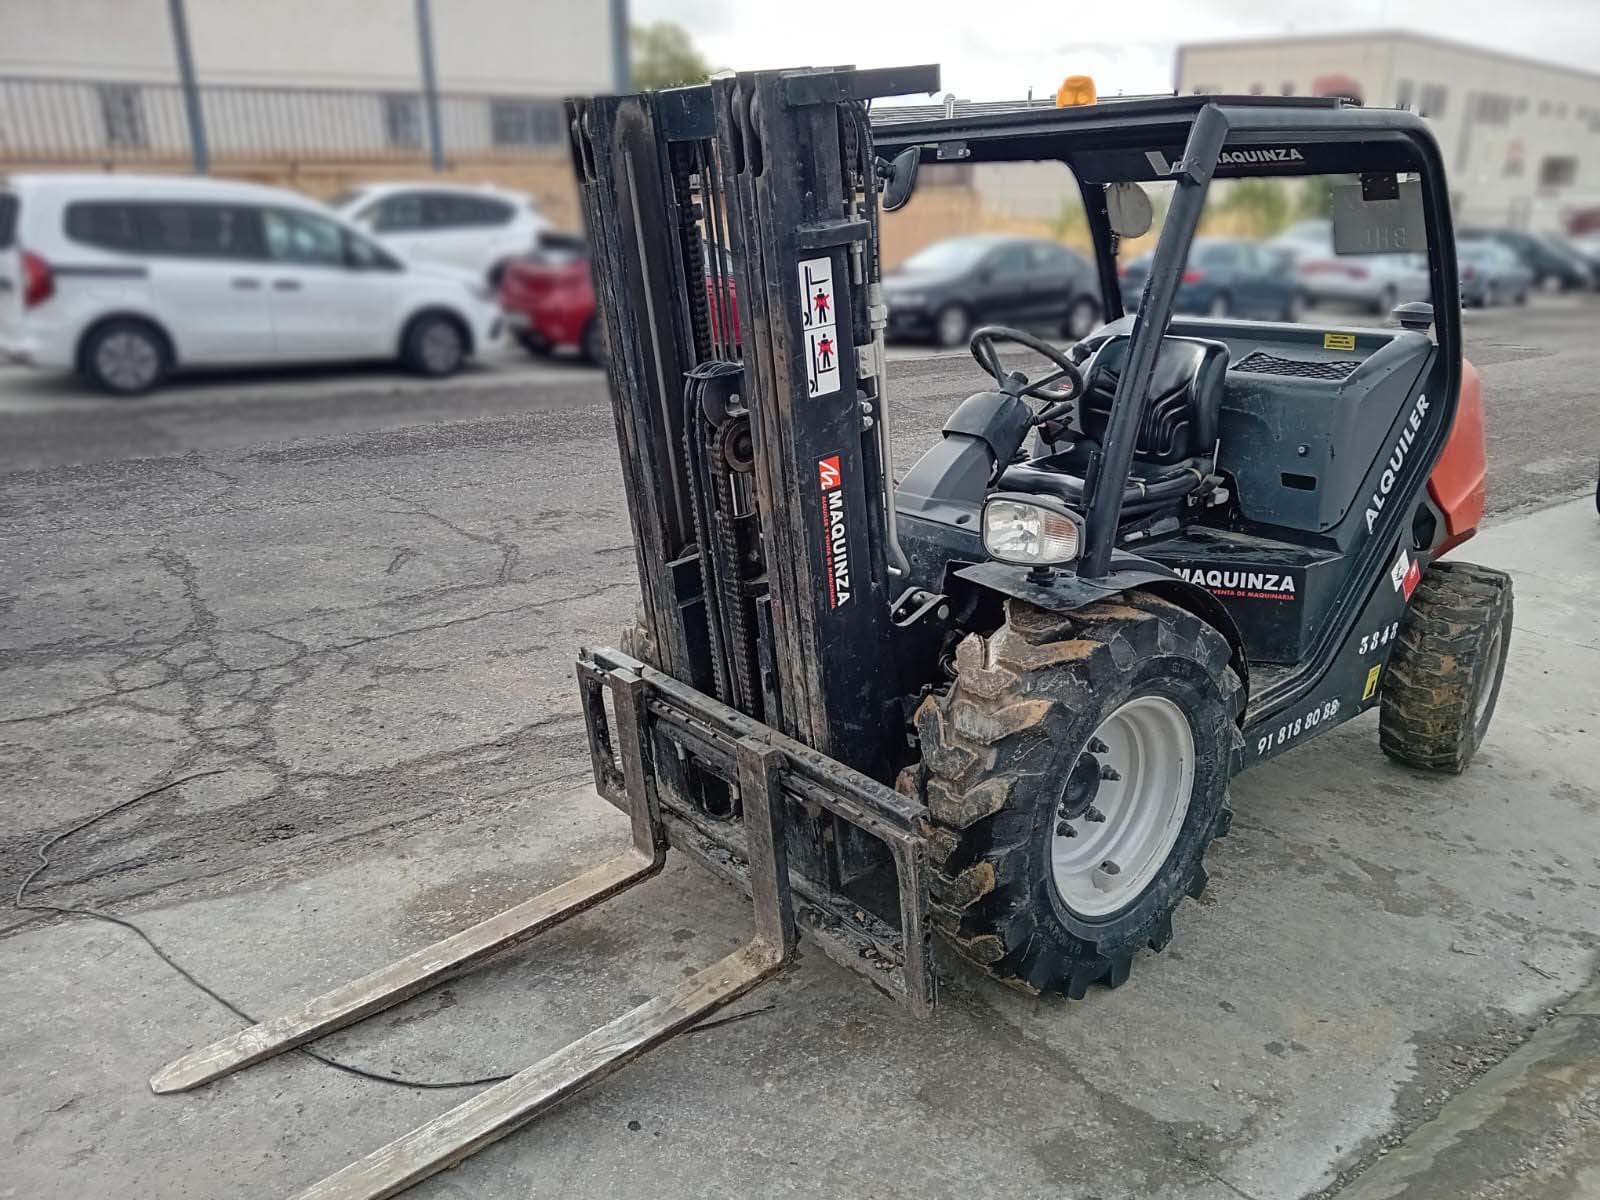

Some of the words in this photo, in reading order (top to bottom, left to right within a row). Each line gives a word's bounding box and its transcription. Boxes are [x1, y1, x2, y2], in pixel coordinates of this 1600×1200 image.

[1217, 148, 1304, 163] AQUINZA
[1365, 394, 1430, 535] ALQUILER
[828, 490, 850, 607] MAQUINZA
[1173, 568, 1295, 592] MAQUINZA
[1213, 588, 1235, 596] VENTA
[1247, 591, 1296, 601] MAQUINARIA
[1257, 732, 1274, 756] 91
[1277, 718, 1302, 745] 818
[1304, 708, 1321, 730] 80
[1322, 699, 1340, 720] 88
